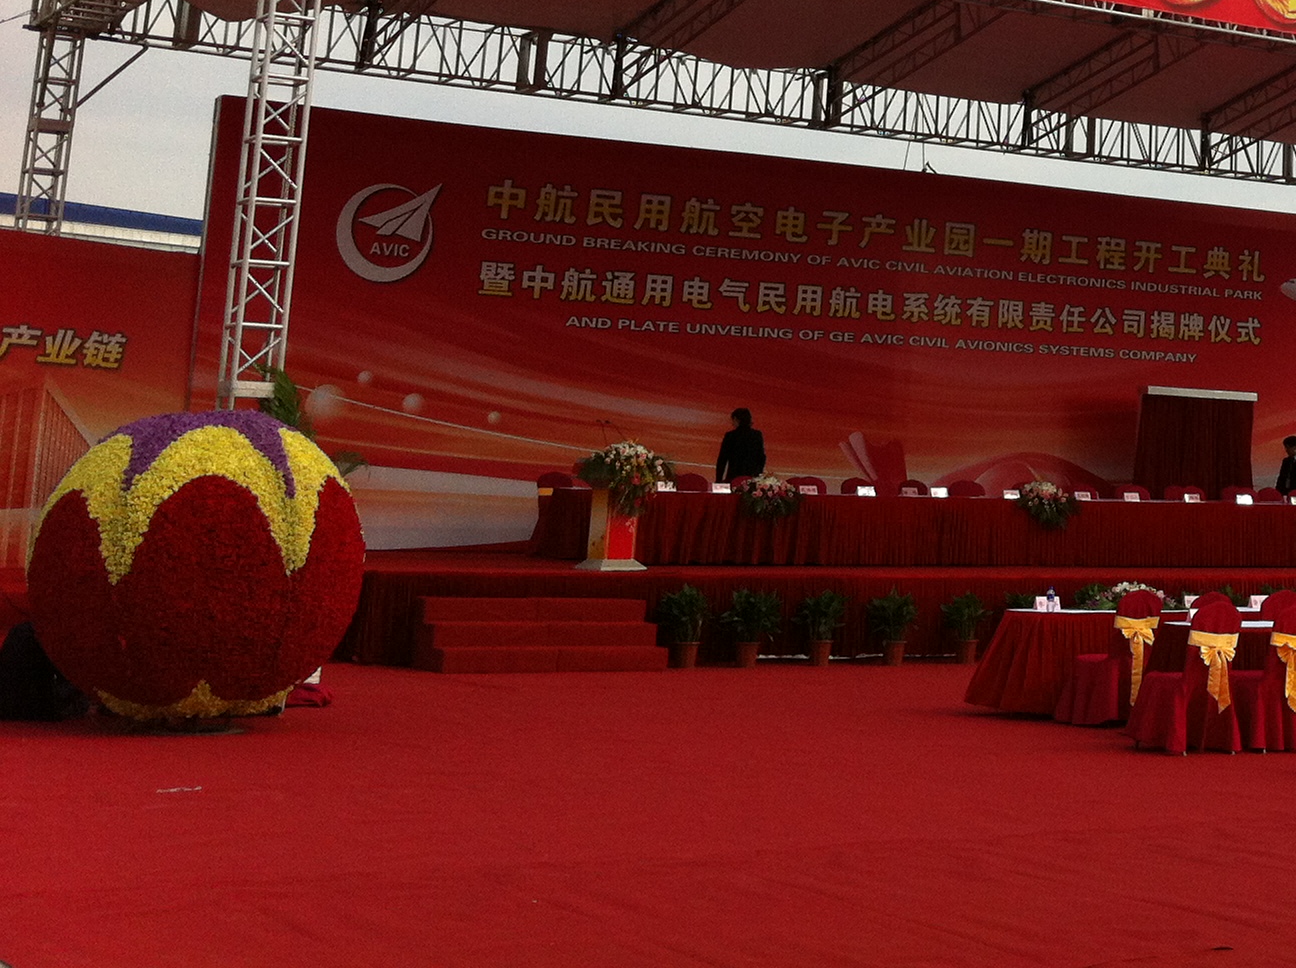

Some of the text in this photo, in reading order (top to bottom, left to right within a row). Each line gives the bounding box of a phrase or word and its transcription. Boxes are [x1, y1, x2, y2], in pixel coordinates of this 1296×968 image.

[370, 242, 411, 257] AVIC
[486, 179, 1266, 283] 中航民用航空电子产业园一期工程开工典礼
[481, 228, 1262, 300] GROUND BREAKING CEREMONY OF AVIC CIVIL AVIATION ELECTRONICS INDUSTRIAL PARK
[478, 261, 1262, 345] 暨中航通用电气民用航电系统有限责任公司揭牌仪式
[0, 325, 128, 369] 产业链
[566, 316, 1198, 363] AND PLATE UNVEILING OF GE AVIC CIVIL AVIONICS SYSTEMS COMPANY
